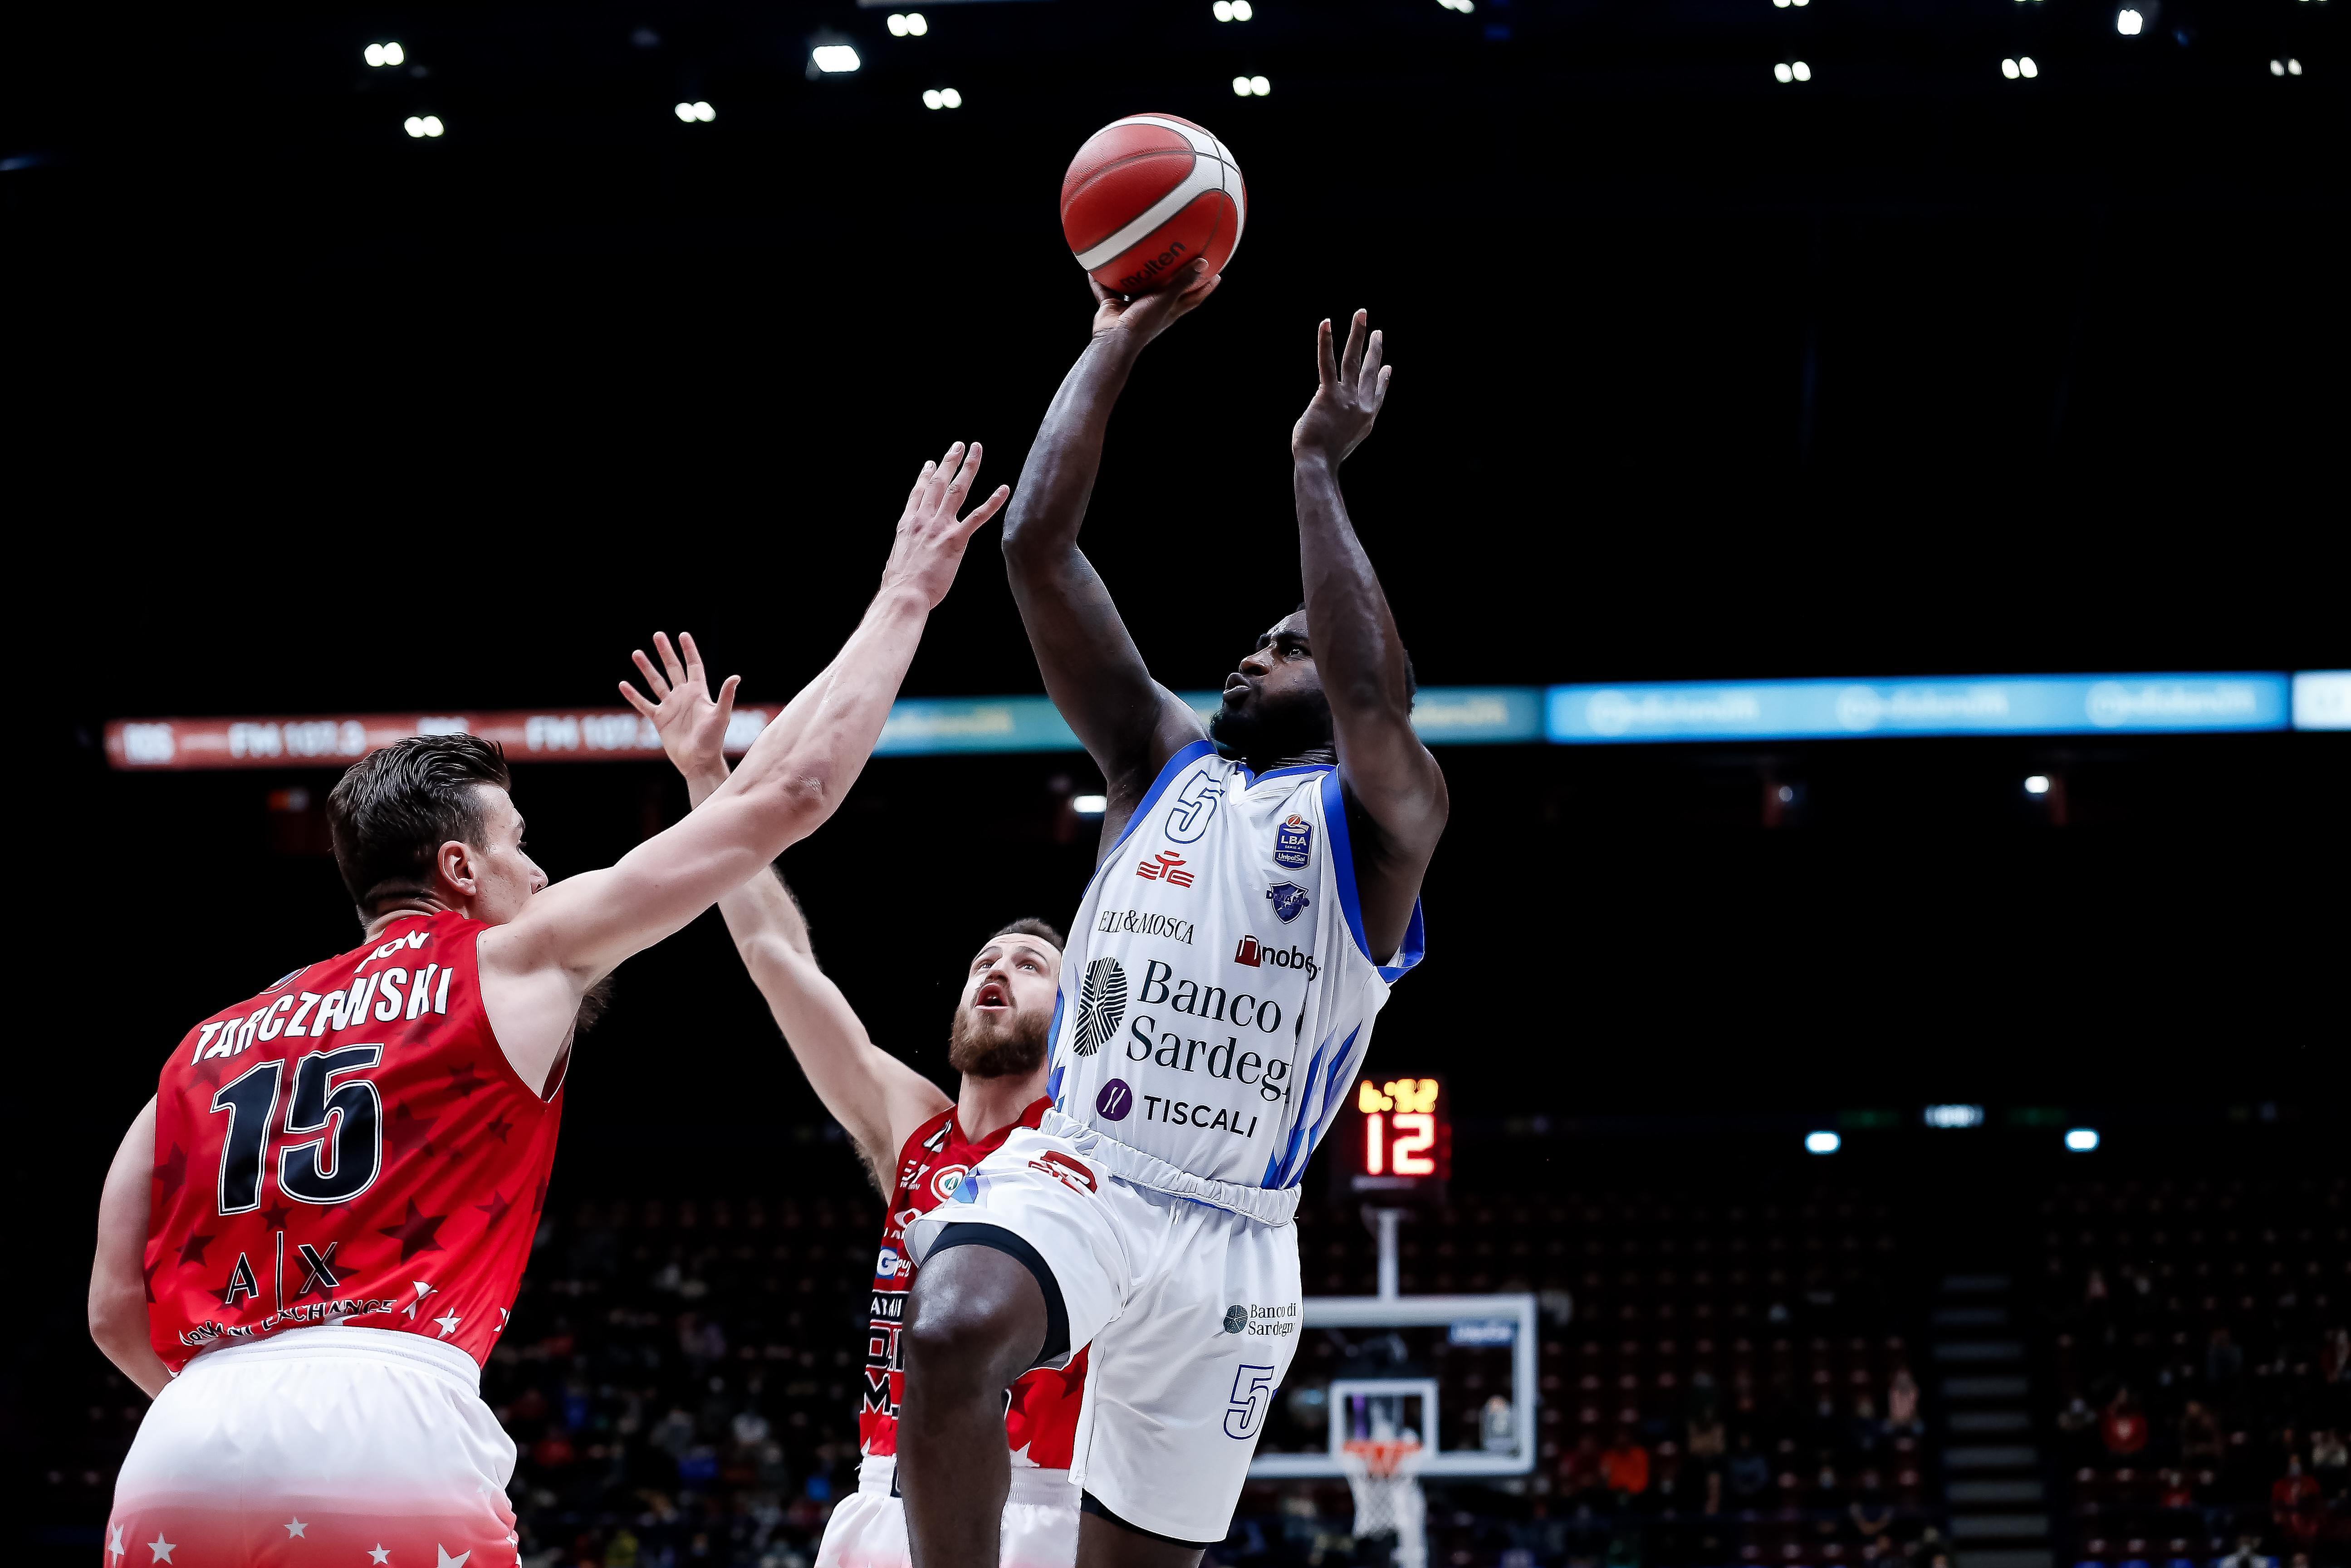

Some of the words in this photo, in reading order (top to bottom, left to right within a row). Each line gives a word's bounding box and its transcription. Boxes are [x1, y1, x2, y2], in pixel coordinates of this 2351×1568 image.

[1119, 241, 1186, 289] molten
[1165, 770, 1225, 844] 5
[1278, 853, 1305, 862] UnipolSai
[1281, 835, 1307, 846] LBA
[1136, 959, 1282, 1035] Banco
[209, 1043, 384, 1216] 15
[1143, 1094, 1258, 1139] TISCALI
[1367, 1112, 1435, 1176] 12
[1248, 1320, 1295, 1337] Sardegn
[1249, 1303, 1285, 1319] Banco
[1287, 1303, 1297, 1317] di
[1223, 1363, 1275, 1441] 5
